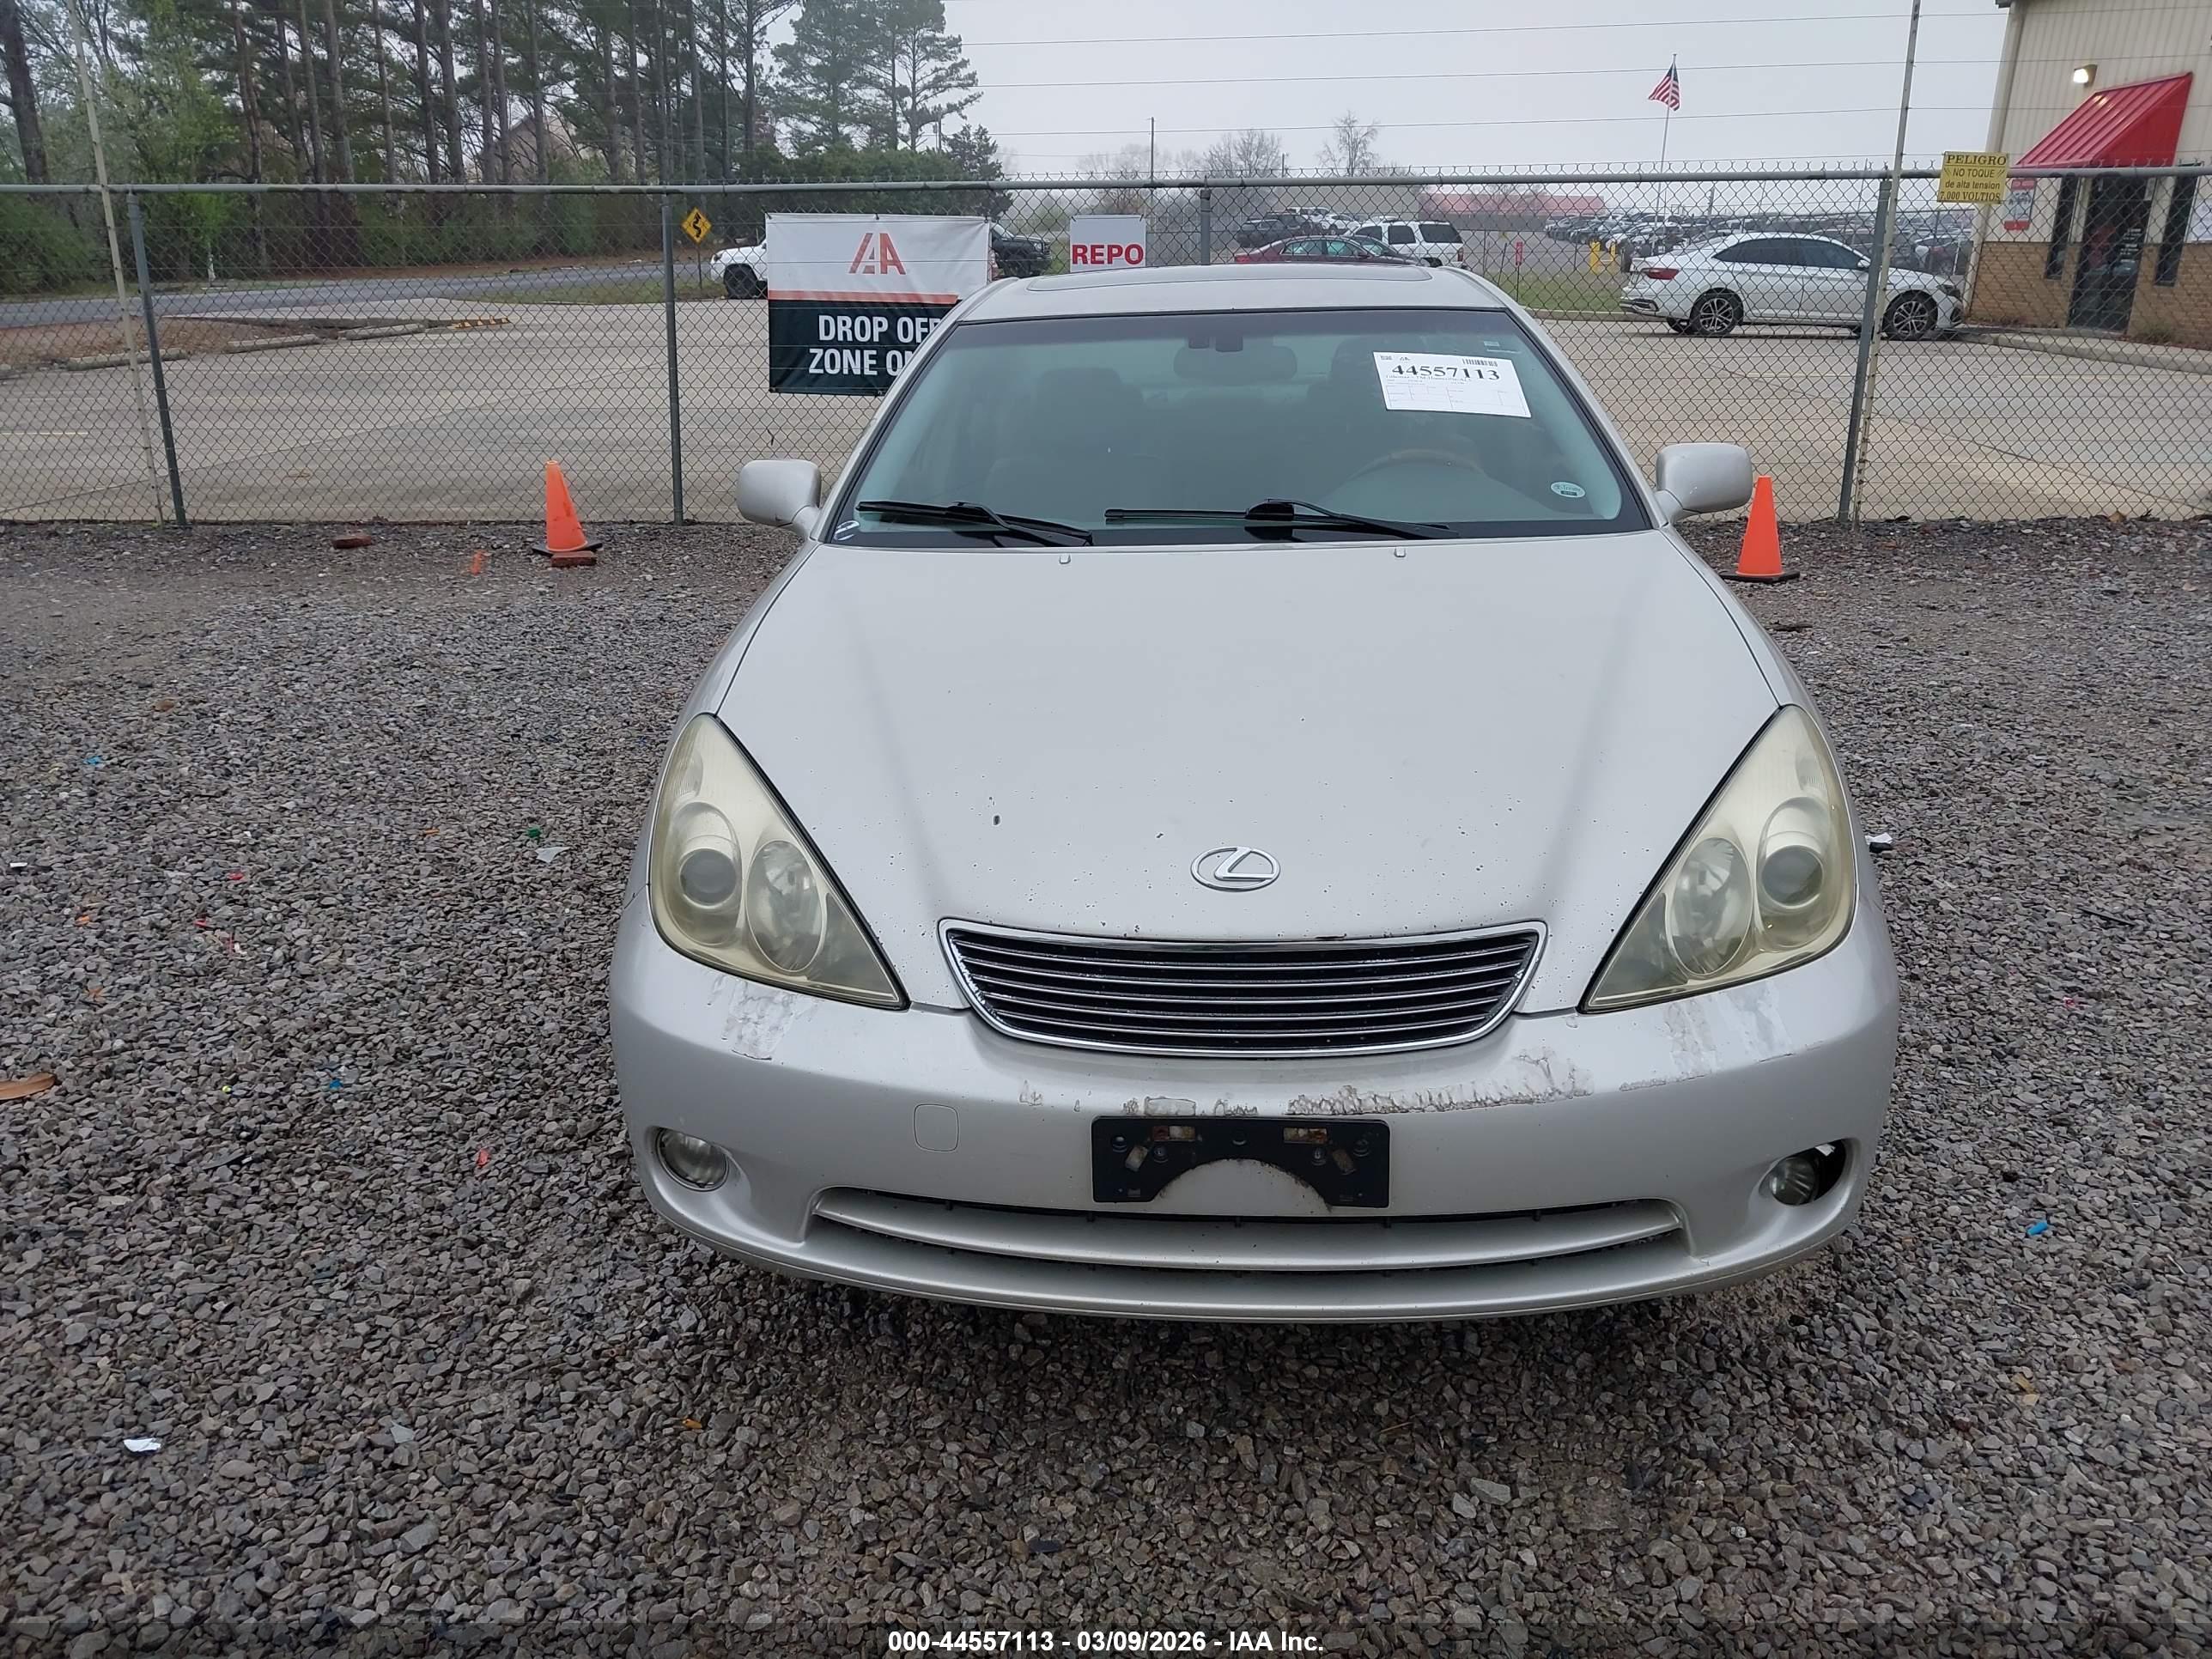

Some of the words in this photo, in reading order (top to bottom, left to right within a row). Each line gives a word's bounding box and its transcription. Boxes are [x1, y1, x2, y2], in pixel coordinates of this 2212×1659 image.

[1946, 155, 2007, 166] PELIGRO
[1953, 168, 1966, 177] NO
[1968, 168, 1996, 178] TOQUE
[1945, 179, 1955, 188] de
[1957, 179, 1971, 189] alta
[1972, 180, 2001, 190] tension
[1962, 191, 2002, 202] VOLTIOS
[1072, 244, 1144, 264] REPO
[818, 315, 888, 342] DROP
[809, 349, 878, 375] ZONE
[1392, 364, 1500, 380] 44557113
